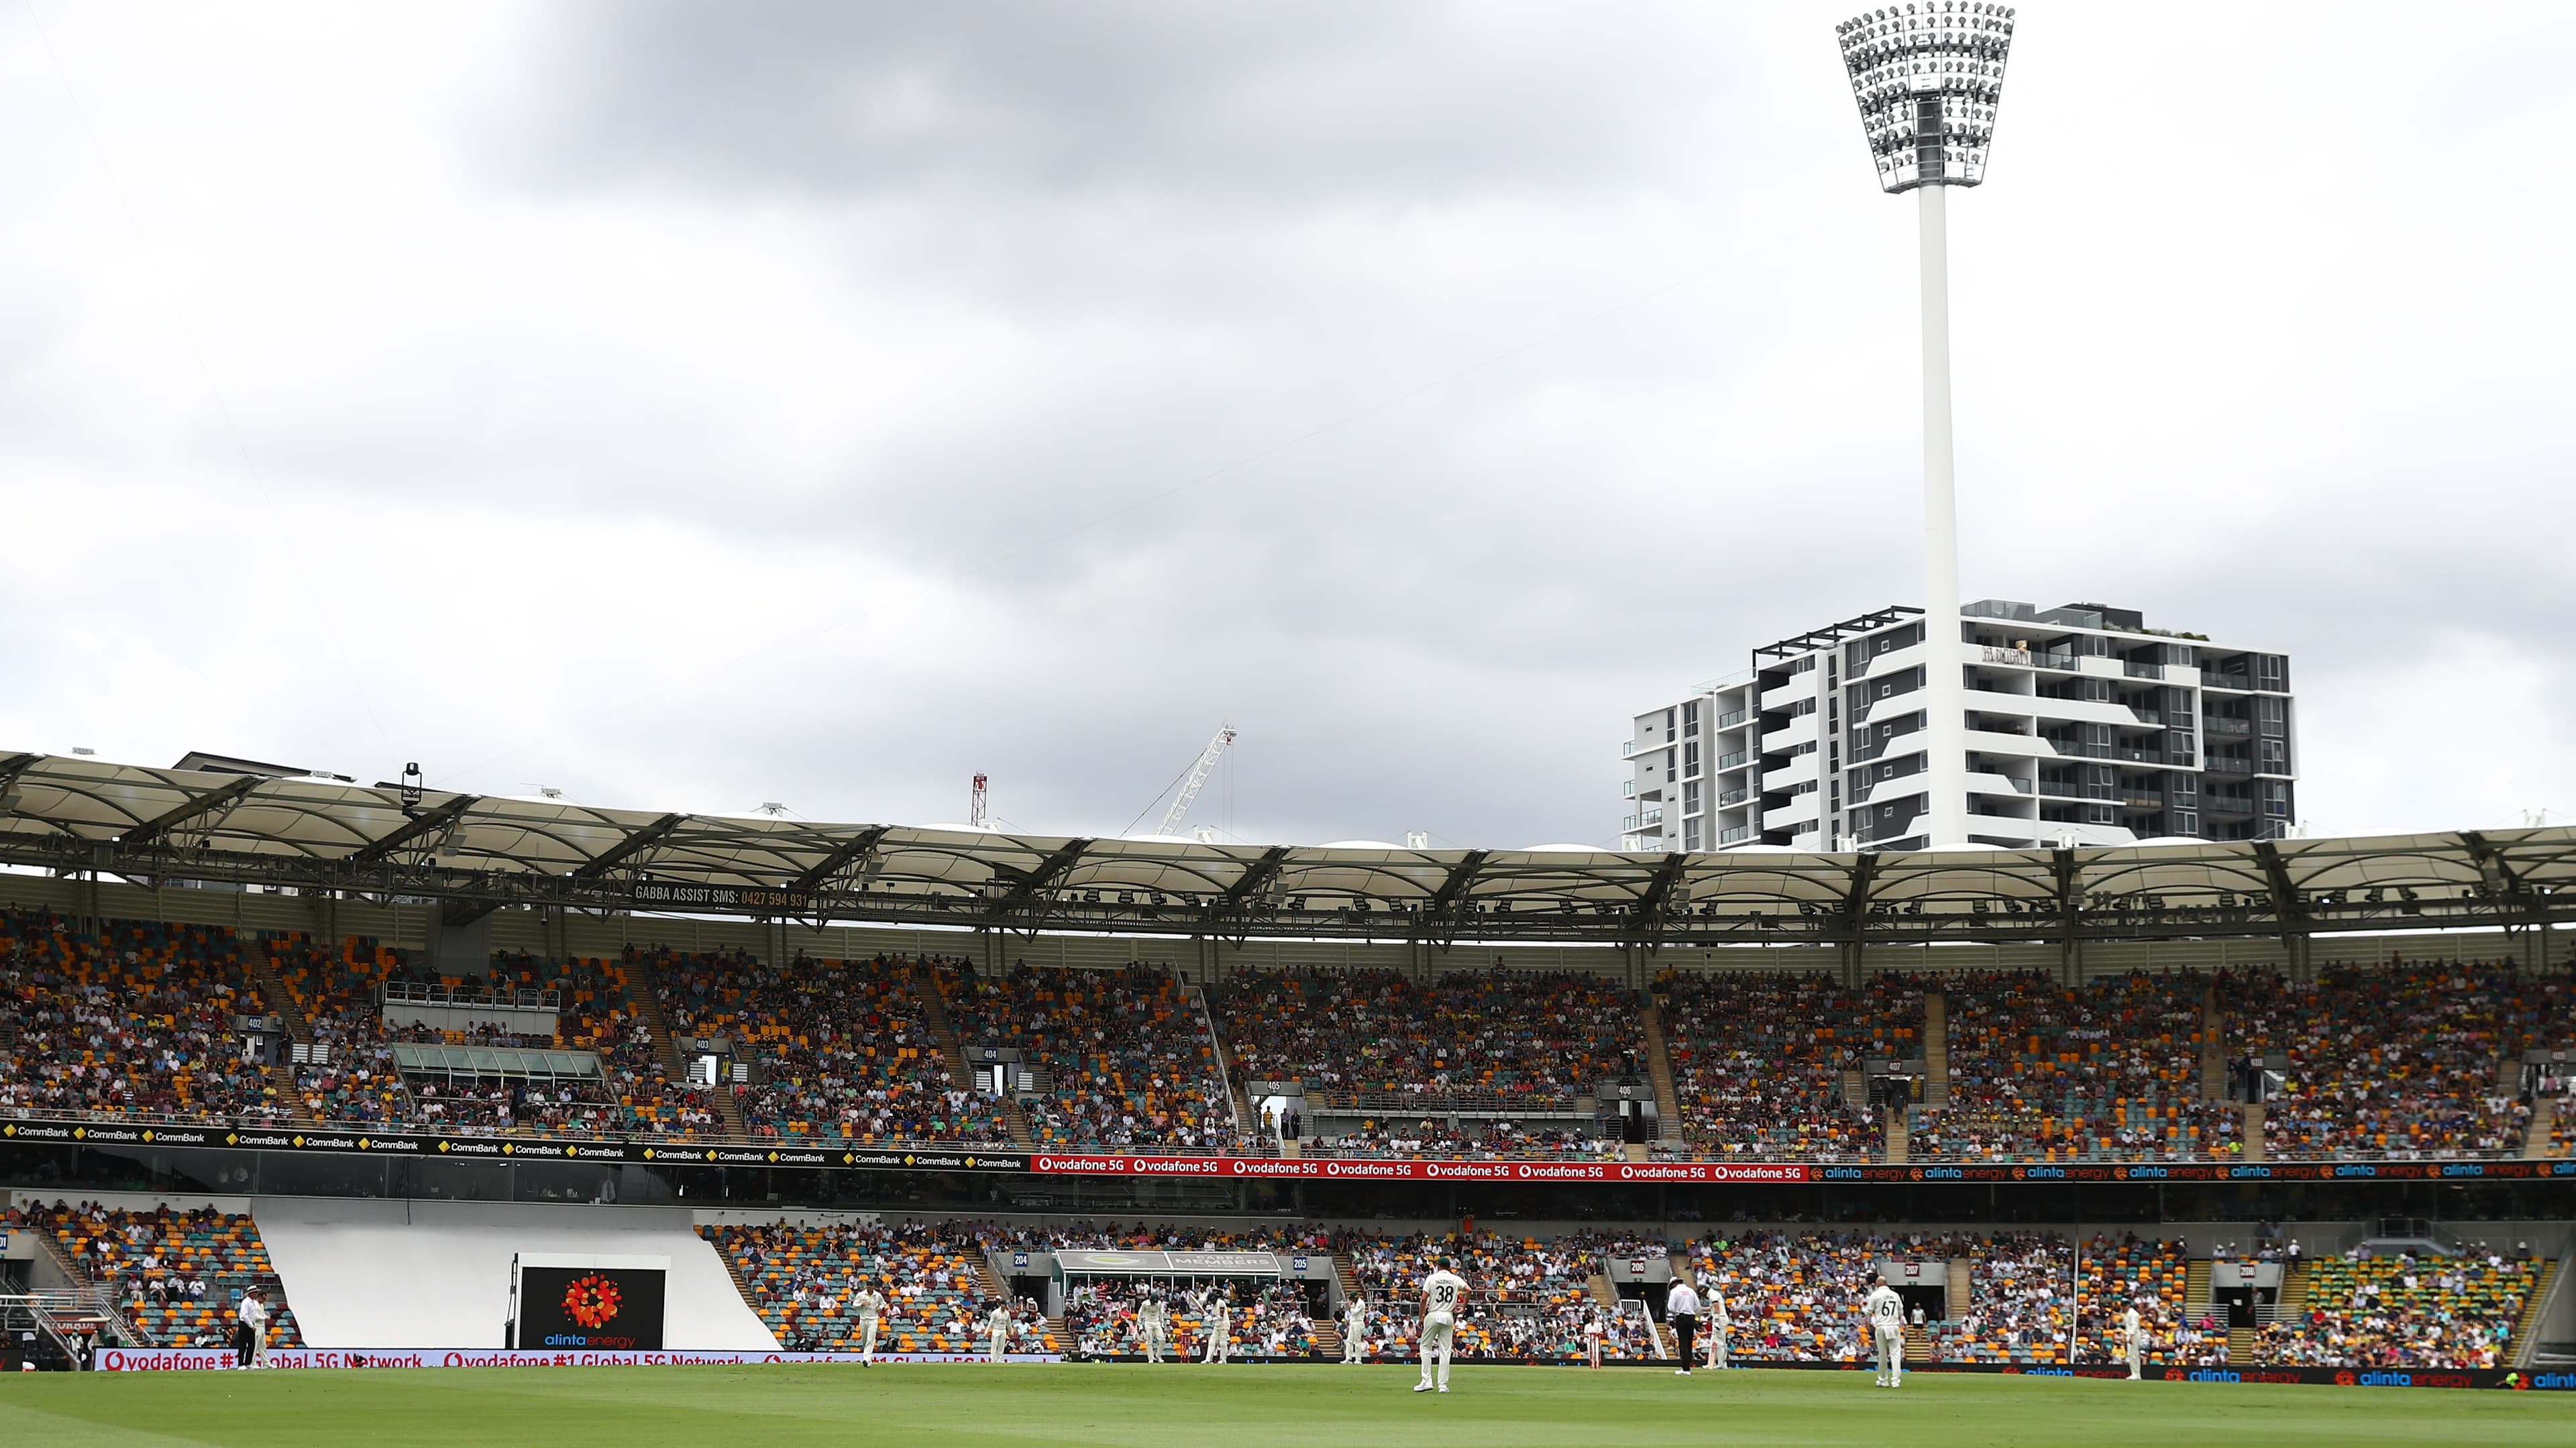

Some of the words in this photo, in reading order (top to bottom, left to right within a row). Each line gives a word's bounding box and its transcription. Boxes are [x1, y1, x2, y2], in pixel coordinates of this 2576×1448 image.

[636, 885, 670, 899] GABBA
[672, 887, 710, 902] ASSIST
[713, 889, 739, 904] SMS:
[742, 891, 765, 905] 0427
[769, 892, 788, 906] 594
[790, 894, 808, 907] 931
[248, 1019, 262, 1028] 402
[696, 1040, 709, 1049] 403
[984, 1050, 996, 1058] 404
[1888, 1062, 1900, 1071] 407
[1268, 1081, 1280, 1090] 405
[1619, 1086, 1631, 1095] 406
[18, 1127, 68, 1137] CommBank
[88, 1129, 137, 1139] CommBank
[156, 1133, 204, 1141] CommBank
[240, 1135, 288, 1145] CommBank
[307, 1137, 354, 1148] CommBank
[372, 1140, 418, 1150] CommBank
[451, 1143, 498, 1152] CommBank
[516, 1146, 561, 1154] CommBank
[579, 1148, 623, 1157] CommBank
[657, 1150, 702, 1159] CommBank
[719, 1152, 763, 1161] CommBank
[781, 1154, 824, 1162] CommBank
[856, 1155, 900, 1164] CommBank
[917, 1157, 961, 1166] CommBank
[977, 1159, 1020, 1168] CommBank
[1053, 1159, 1106, 1170] vodafone
[1109, 1160, 1124, 1170] 5G
[1147, 1161, 1199, 1172] vodafone
[1203, 1162, 1217, 1172] 5G
[1246, 1163, 1299, 1173] vodafone
[1303, 1164, 1317, 1173] 5G
[1340, 1164, 1393, 1174] vodafone
[1397, 1165, 1411, 1175] 5G
[1440, 1166, 1491, 1176] vodafone
[1495, 1166, 1509, 1176] 5G
[1534, 1166, 1585, 1176] vodafone
[1589, 1167, 1603, 1177] 5G
[1634, 1168, 1687, 1177] vodafone
[1690, 1168, 1705, 1178] 5G
[1729, 1168, 1782, 1178] vodafone
[1785, 1168, 1800, 1178] 5G
[1015, 1256, 1027, 1265] 204
[1175, 1258, 1270, 1266] MEMBERS
[1294, 1259, 1306, 1268] 205
[1631, 1262, 1644, 1272] 206
[1906, 1265, 1919, 1275] 207
[1436, 1286, 1454, 1303] 38
[1882, 1300, 1896, 1316] 67
[545, 1333, 636, 1349] alintaenergy
[127, 1353, 215, 1370] vodafone
[315, 1353, 338, 1368] 5G
[465, 1353, 549, 1366] vodafone
[553, 1353, 575, 1366] #1
